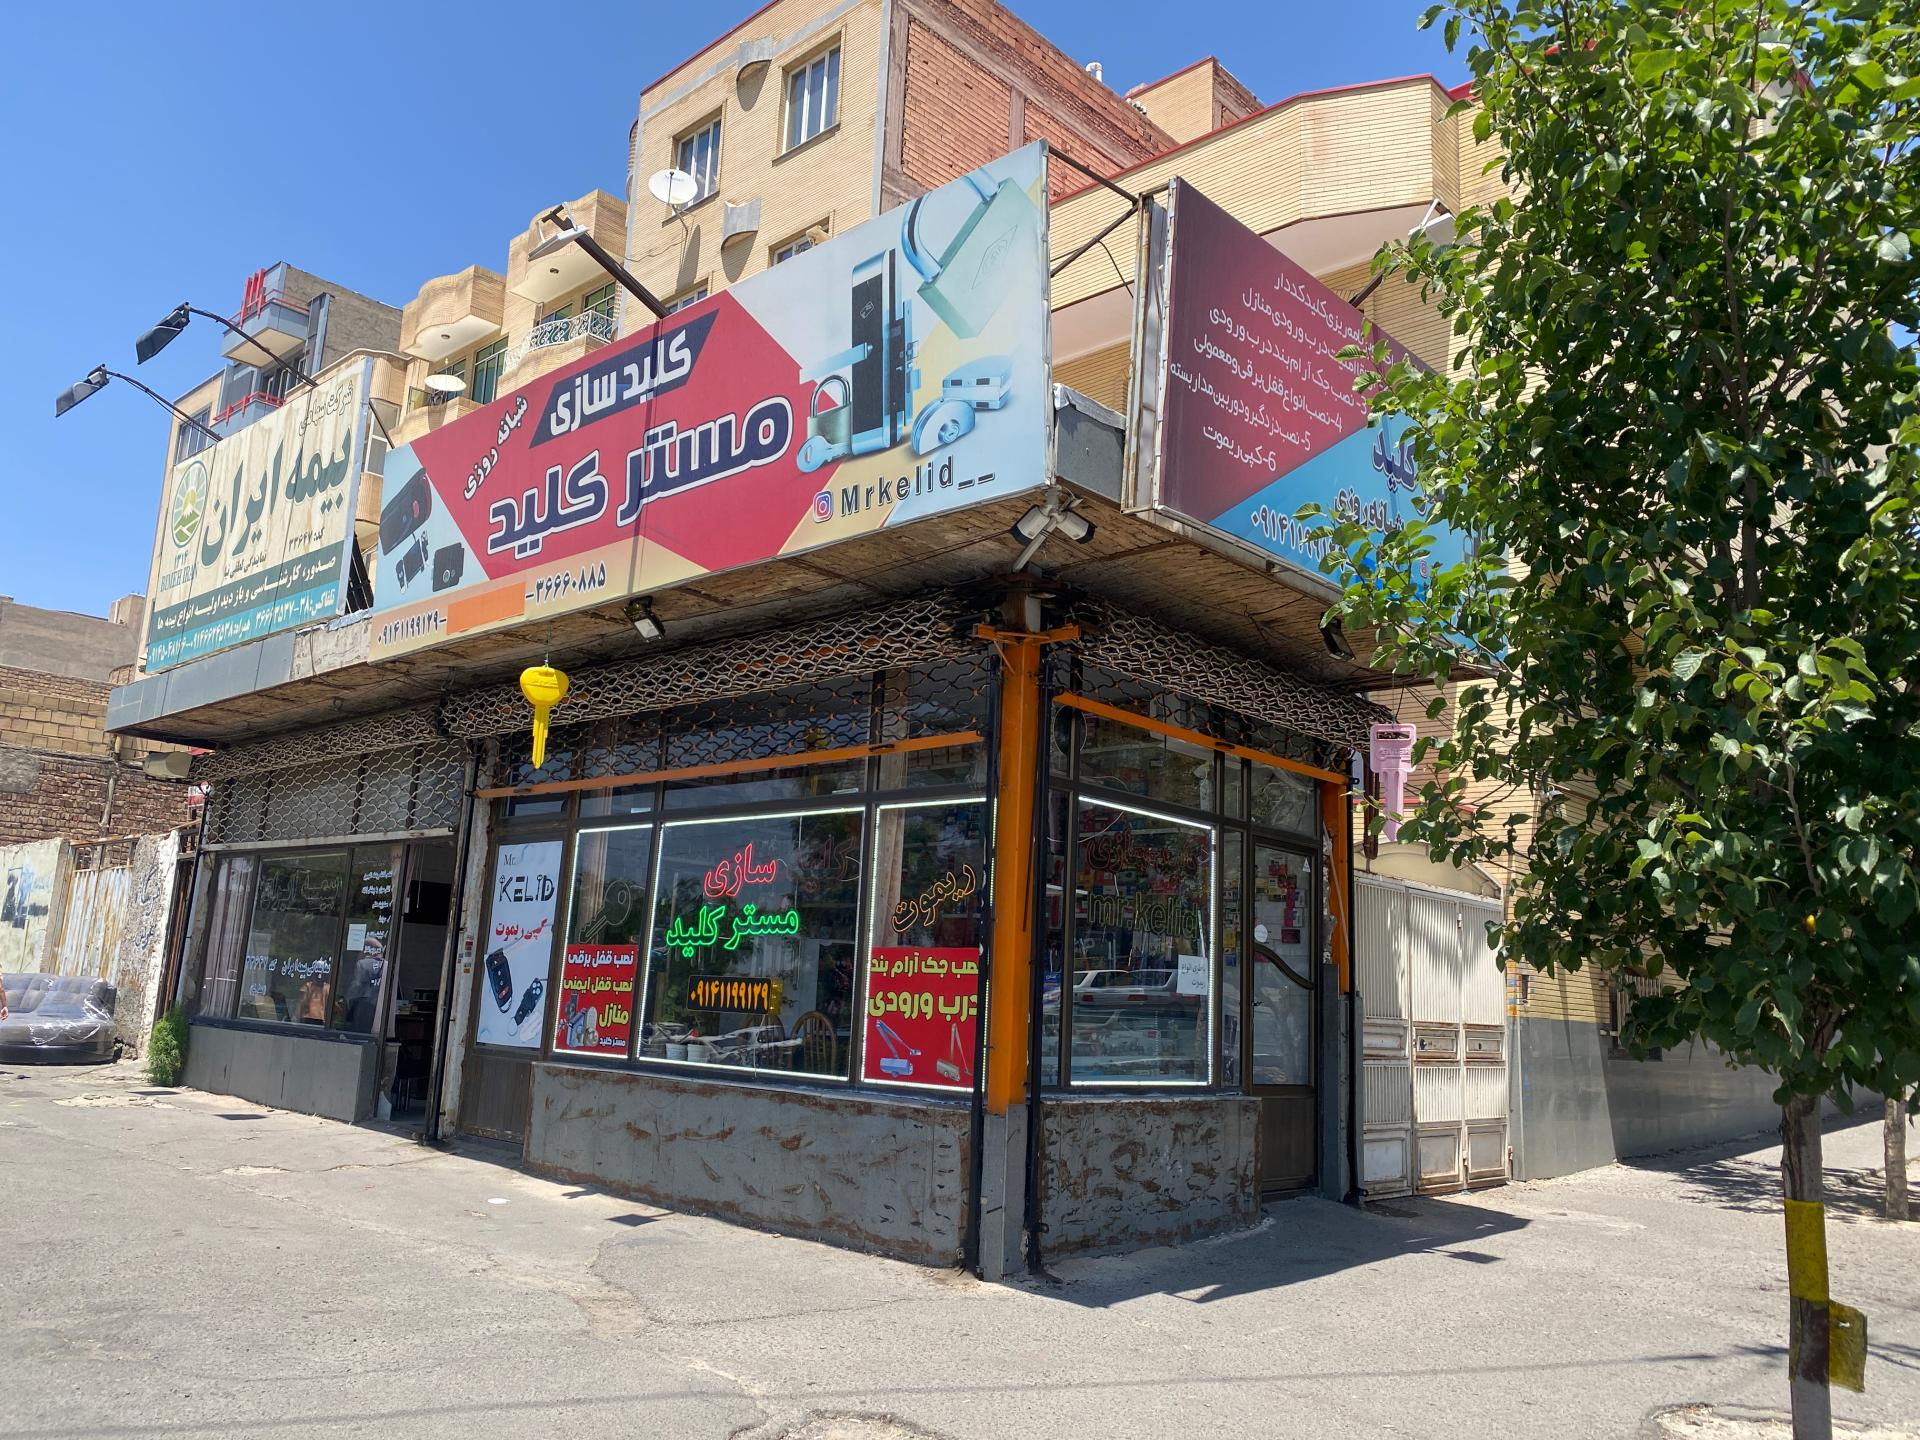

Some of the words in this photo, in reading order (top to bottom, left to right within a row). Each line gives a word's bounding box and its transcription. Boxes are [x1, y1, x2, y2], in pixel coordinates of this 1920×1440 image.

[1242, 287, 1272, 317] منازل
[1209, 308, 1247, 342] ورودی
[621, 328, 693, 403] کلید
[1312, 368, 1331, 396] جک
[549, 372, 618, 437] سازی
[497, 395, 529, 446] شبانه
[1202, 425, 1242, 461] ریموت
[284, 427, 352, 516] بیمه
[463, 446, 499, 501] روزی
[616, 395, 795, 529] مستر
[1373, 428, 1417, 493] کلید
[200, 437, 284, 569] ایران
[487, 449, 609, 561] کلید
[160, 568, 183, 592] BIMEH
[250, 562, 302, 601] کارشناسی
[194, 594, 221, 616] اولیه
[703, 842, 779, 899] سازی
[498, 873, 555, 903] KELID
[892, 864, 977, 932] ریموت
[495, 921, 525, 942] ریموت
[524, 916, 548, 941] کپی
[665, 904, 727, 958] کلید
[724, 903, 801, 951] مستر
[568, 949, 592, 968] برقی
[592, 949, 613, 968] قفل
[613, 950, 634, 968] نصب
[870, 954, 889, 977] بند
[890, 951, 920, 978] آرام
[921, 956, 949, 978] جک
[951, 960, 979, 979] صب
[563, 975, 591, 994] ایمنی
[591, 976, 611, 994] قفل
[613, 976, 633, 995] نصب
[690, 979, 769, 1011] ۰۹۱۴۱۱۹۹۱۲۹
[598, 1002, 630, 1028] منازل
[868, 990, 934, 1021] ورودی
